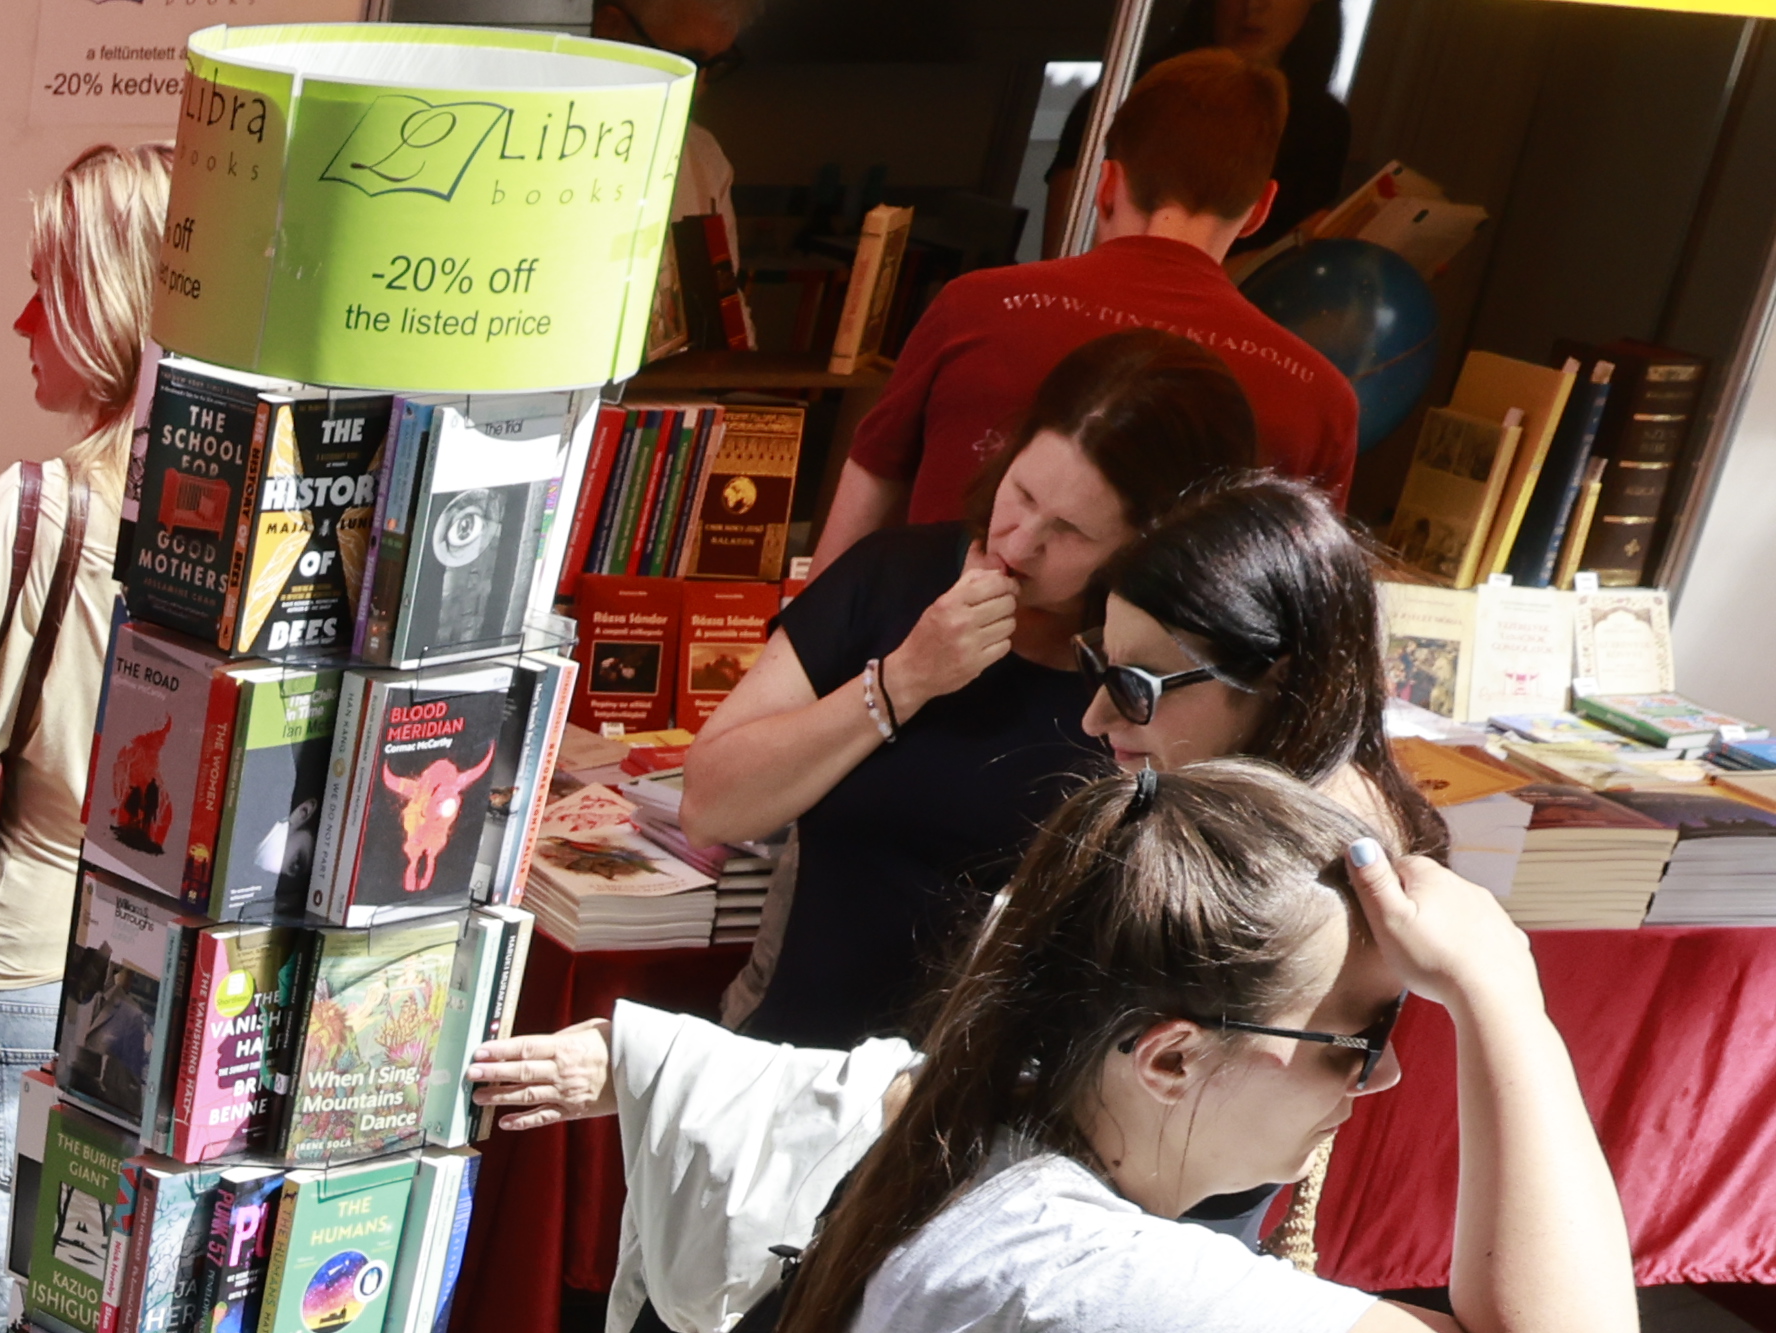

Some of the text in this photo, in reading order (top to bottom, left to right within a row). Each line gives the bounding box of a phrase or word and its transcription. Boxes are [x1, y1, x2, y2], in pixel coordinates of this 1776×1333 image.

[100, 44, 175, 62] feltüntetett
[44, 73, 103, 95] -20%
[495, 100, 635, 163] Libra
[492, 179, 623, 206] books
[173, 218, 195, 253] off
[371, 255, 539, 294] -20% off
[344, 304, 551, 341] the listed price
[161, 425, 243, 465] SCHOOL
[261, 475, 376, 512] HISTOR
[157, 529, 216, 564] GOOD
[137, 553, 230, 594] MOTHERS
[299, 550, 336, 578] OF
[116, 657, 180, 693] THE ROAD
[390, 701, 447, 724] BLOOD
[385, 735, 453, 754] Cormac McCarthy
[387, 717, 465, 742] MERIDIAN
[206, 752, 224, 813] WOMEN
[187, 1001, 205, 1077] VANISHING
[307, 1066, 422, 1089] When I Sing,
[302, 1090, 403, 1113] Mountains
[359, 1111, 417, 1132] Dance
[69, 1161, 110, 1189] GIANT
[210, 1189, 236, 1238] PUNK
[337, 1197, 372, 1216] THE
[310, 1216, 389, 1246] HUMANS
[52, 1270, 97, 1304] KAZUO
